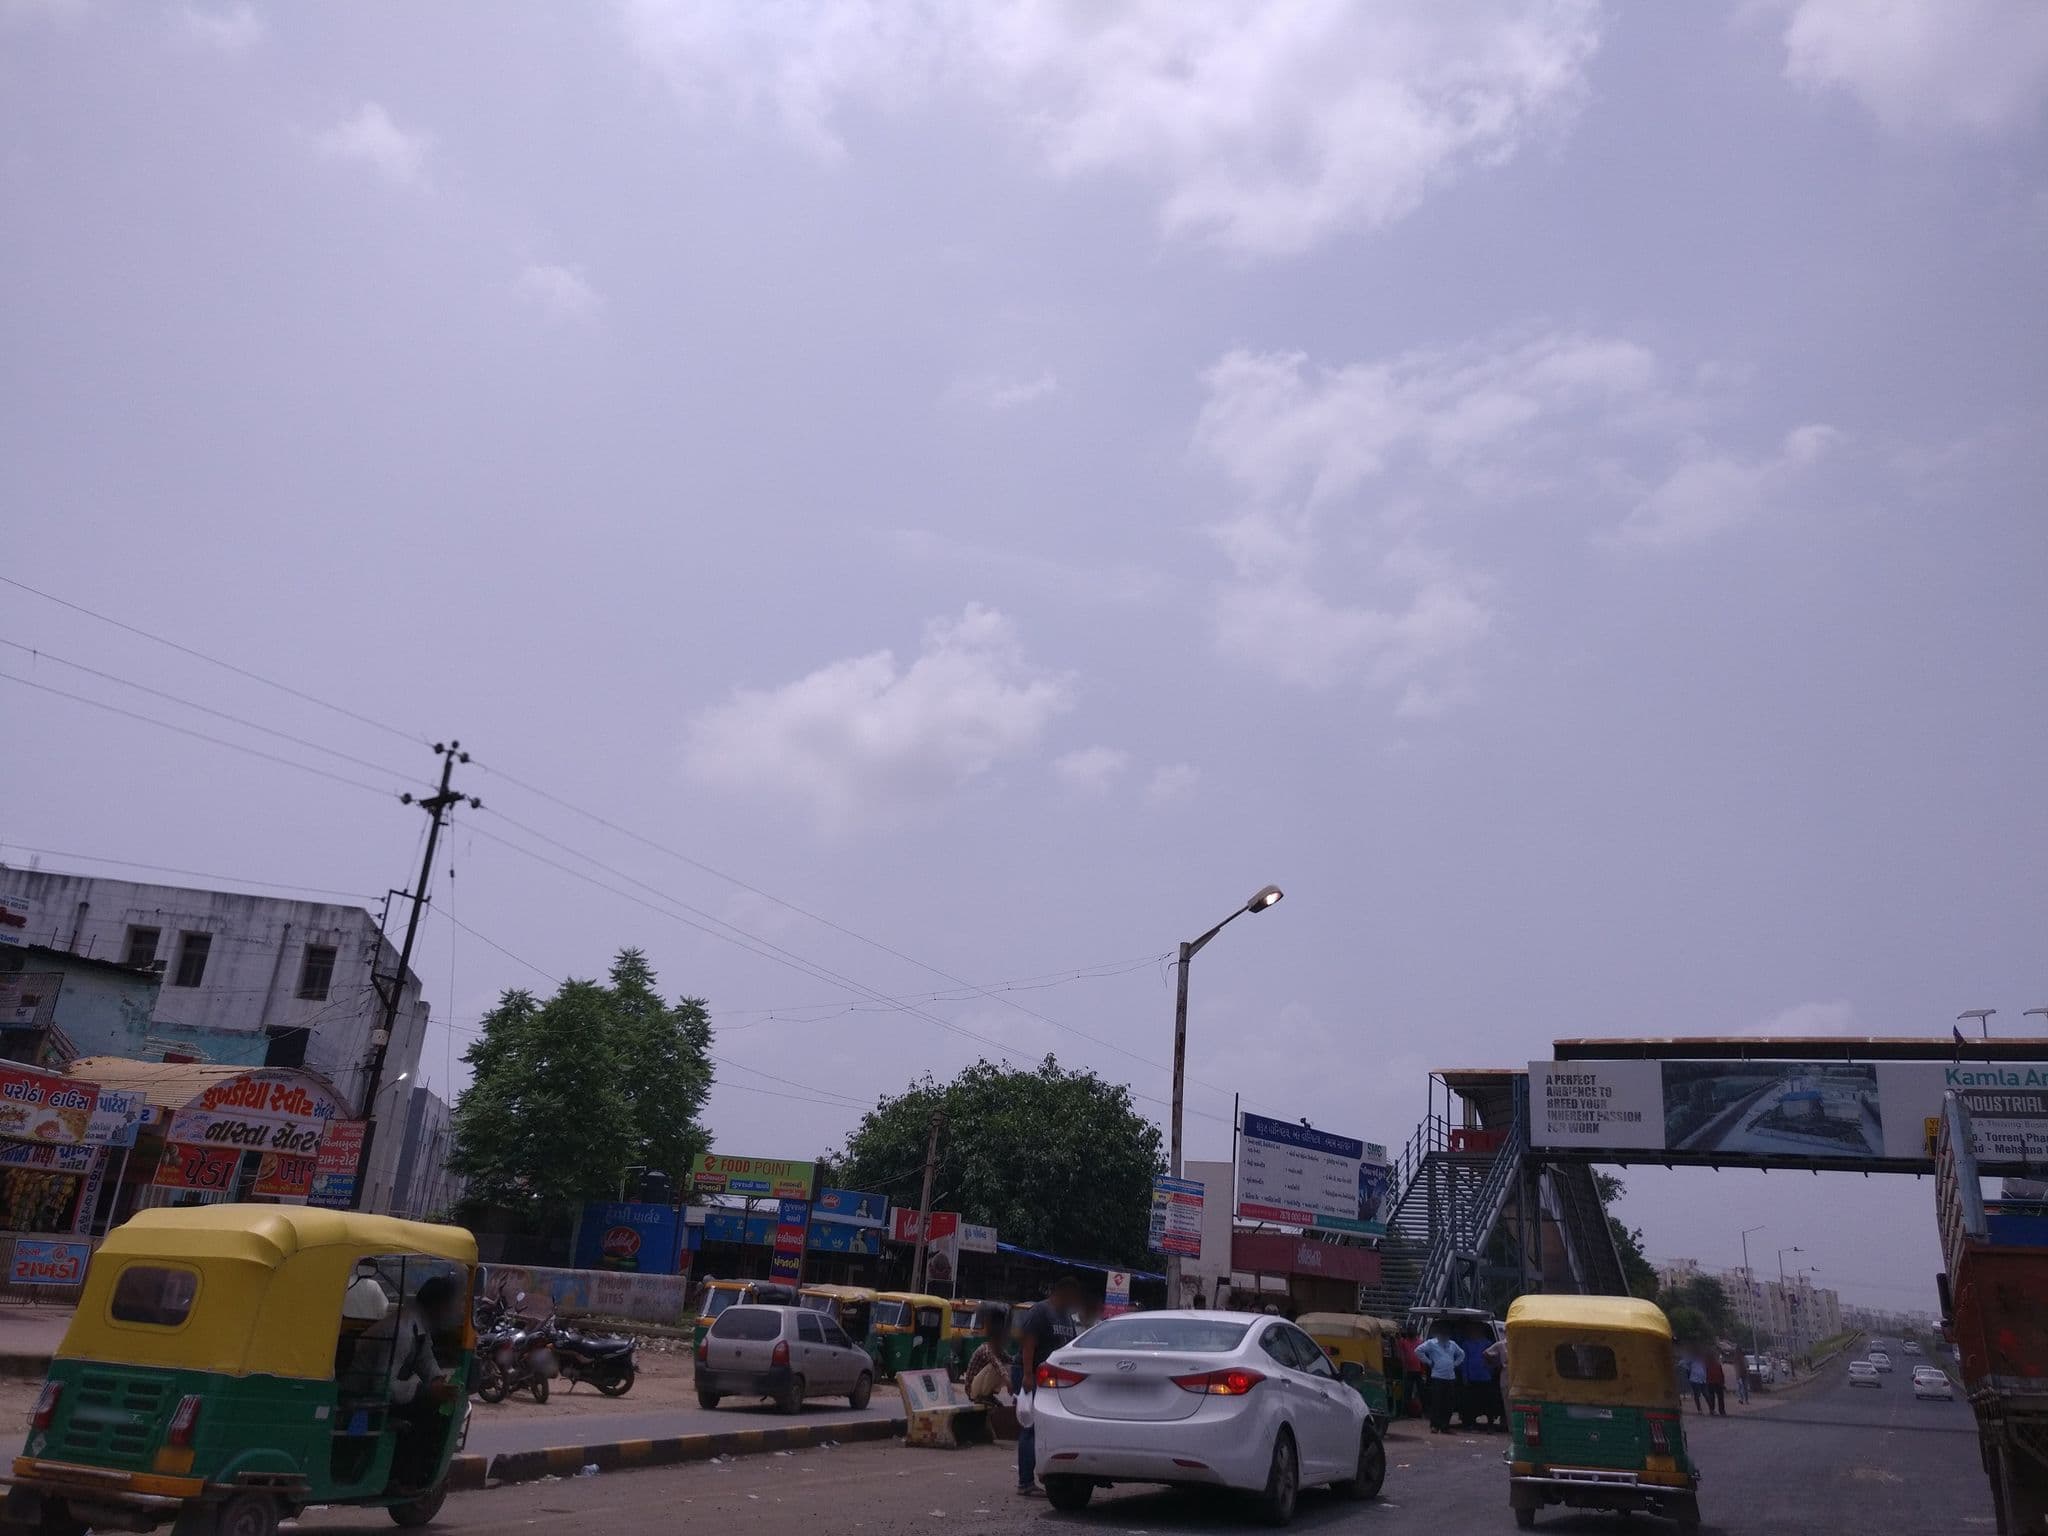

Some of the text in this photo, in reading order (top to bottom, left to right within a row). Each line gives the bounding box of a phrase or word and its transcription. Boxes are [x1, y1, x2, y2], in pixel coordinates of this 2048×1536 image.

[1546, 1074, 1597, 1086] A PERFECT
[1945, 1068, 2020, 1086] Kamla
[3, 1081, 90, 1110] પરોઠા હાઉસ
[1546, 1087, 1612, 1098] AMBIENCE TO
[1547, 1099, 1607, 1109] BREED YOUR
[1959, 1096, 2048, 1113] NDUSTRIAL
[1547, 1110, 1642, 1122] INHERENT PASSION
[205, 1119, 270, 1146] નાસ્તા
[1568, 1122, 1599, 1134] WORK
[1985, 1132, 2022, 1142] Torrent
[720, 1159, 795, 1176] FOOD POINT
